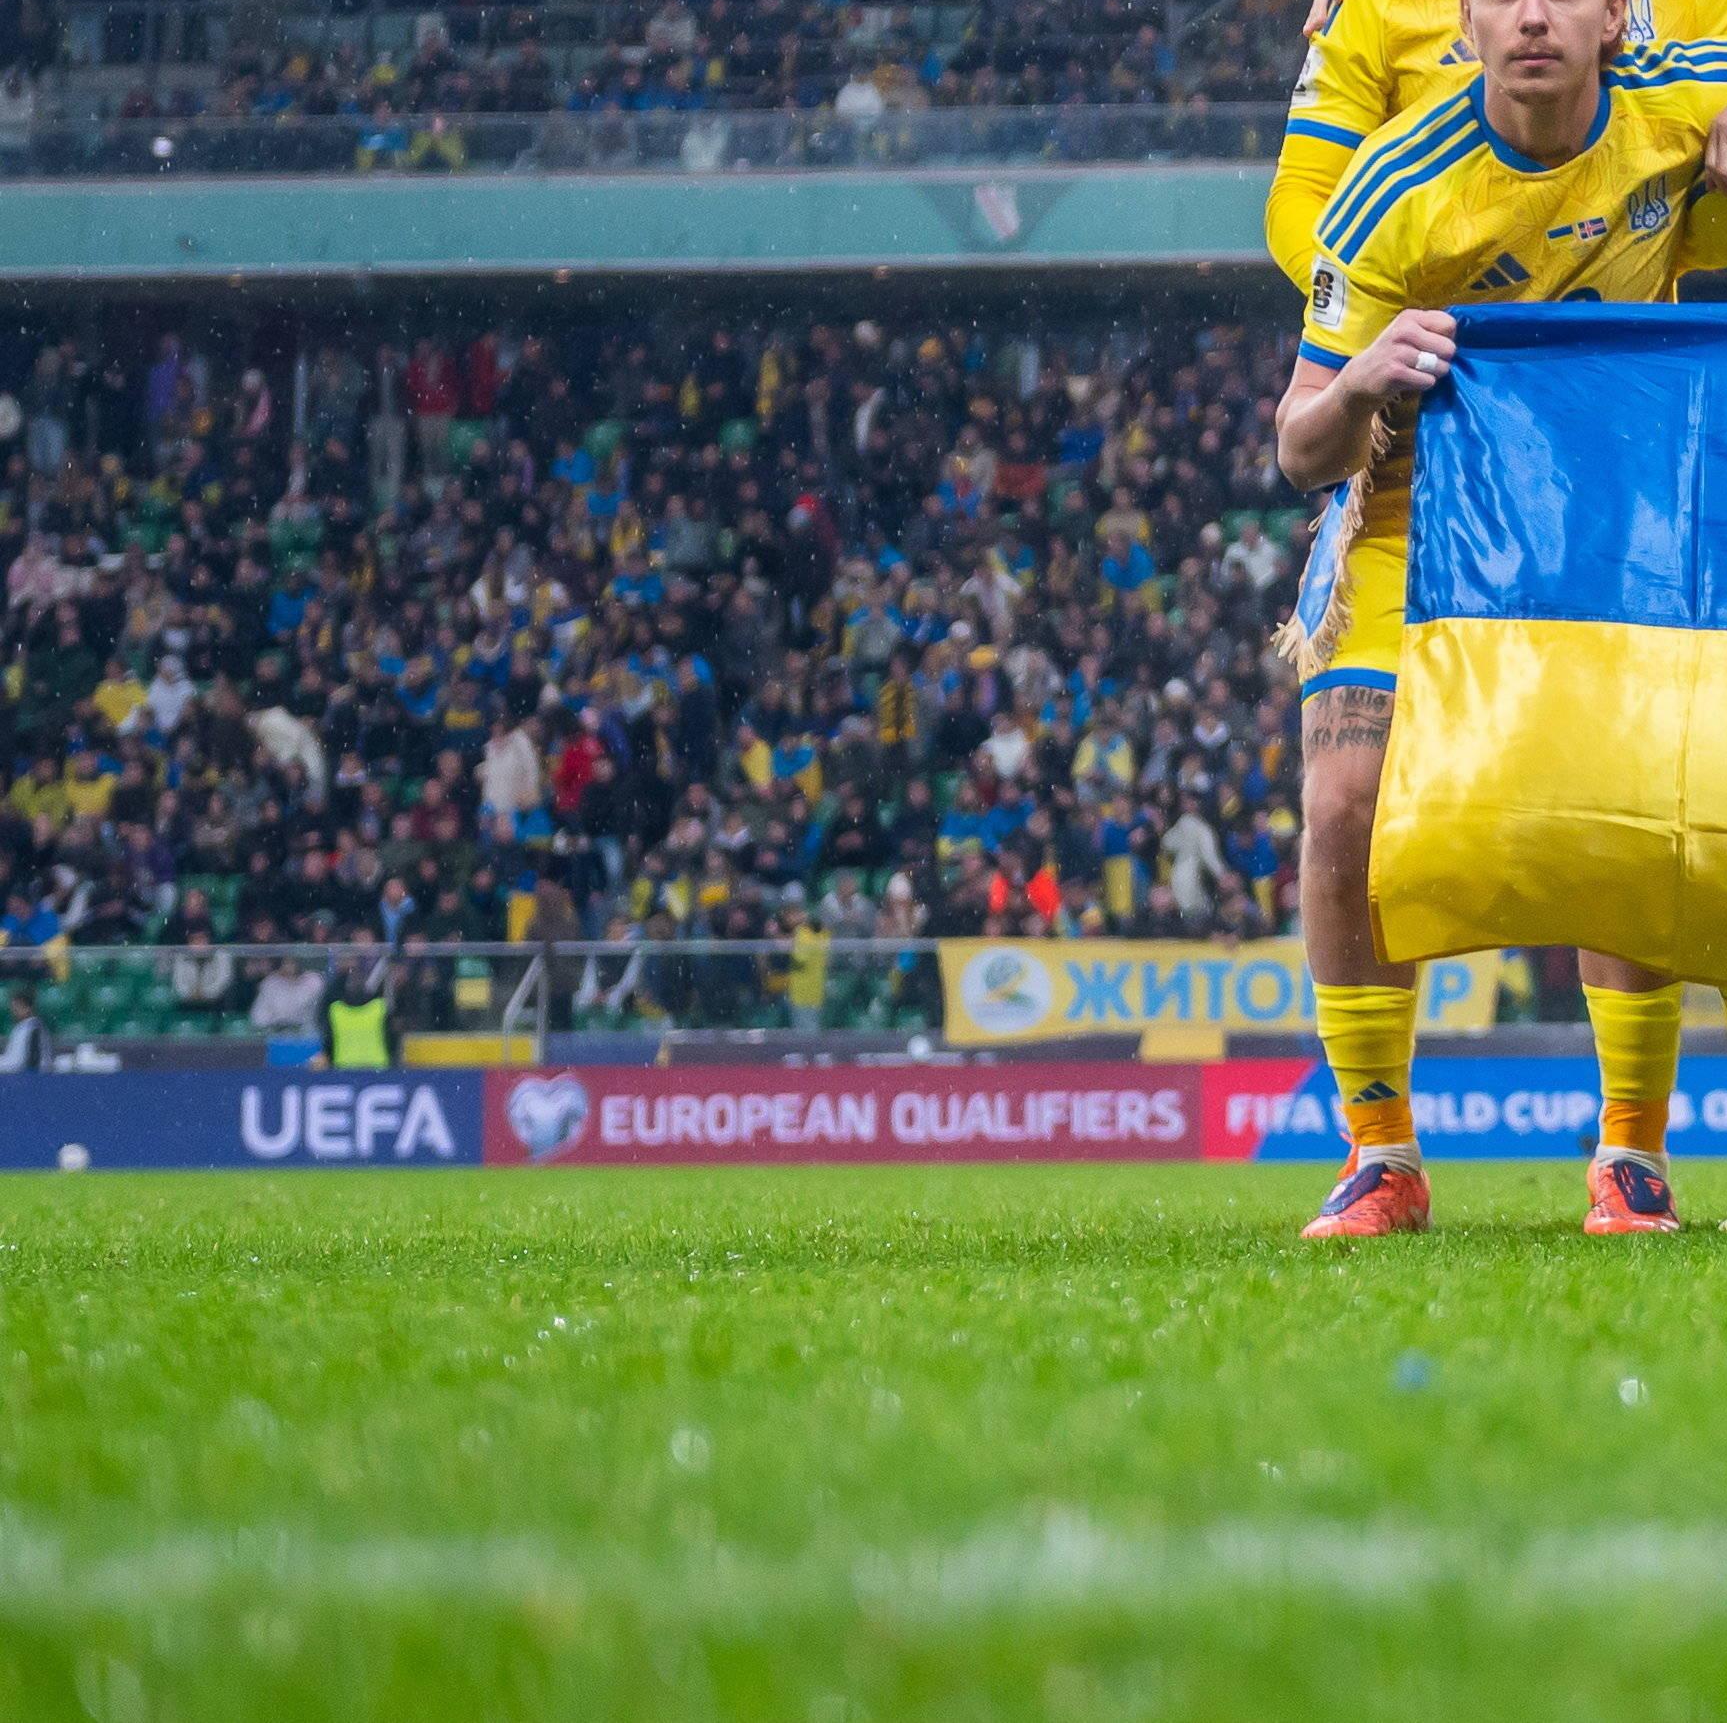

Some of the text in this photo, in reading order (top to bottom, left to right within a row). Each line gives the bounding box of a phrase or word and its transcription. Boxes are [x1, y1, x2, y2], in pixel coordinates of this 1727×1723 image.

[1064, 959, 1473, 1021] ЖИТОР
[240, 1084, 456, 1159] UEFA
[599, 1089, 1187, 1146] EUROPEAN QUALIFIERS
[1226, 1092, 1327, 1136] FIFA
[1503, 1090, 1598, 1135] CUP
